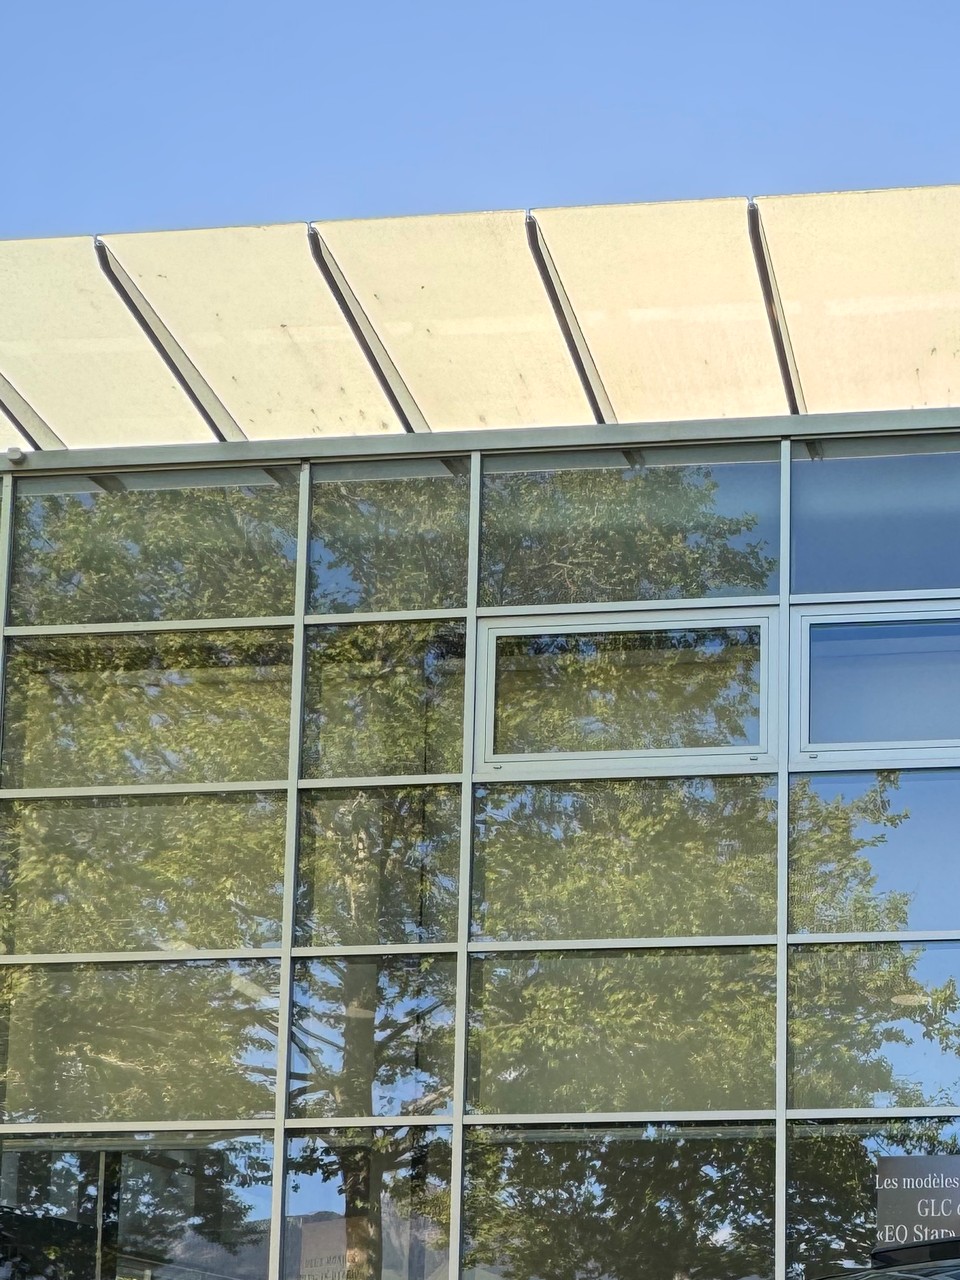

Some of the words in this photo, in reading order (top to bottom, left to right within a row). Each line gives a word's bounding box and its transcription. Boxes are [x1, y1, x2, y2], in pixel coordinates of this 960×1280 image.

[875, 1174, 899, 1190] Les
[902, 1173, 959, 1189] modèles
[917, 1199, 952, 1217] GLC
